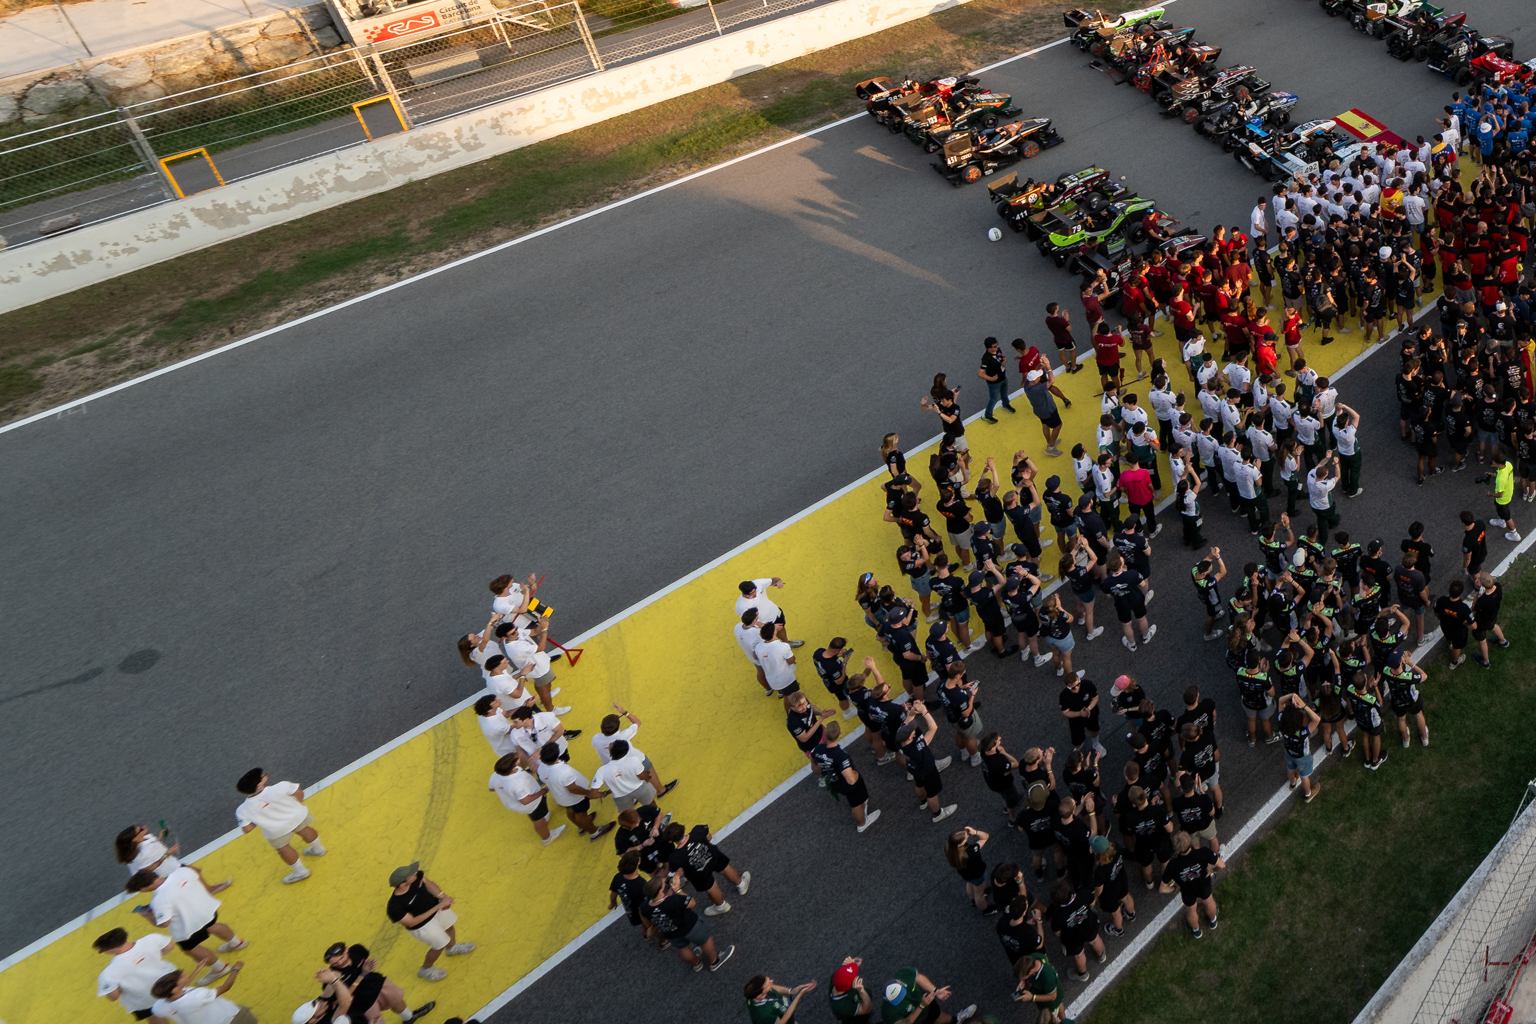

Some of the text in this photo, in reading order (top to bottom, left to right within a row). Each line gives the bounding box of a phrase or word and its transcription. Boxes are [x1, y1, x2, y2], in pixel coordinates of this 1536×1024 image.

[439, 0, 479, 14] Circuit de
[441, 5, 481, 20] Barcelona
[1304, 162, 1318, 174] 492
[1015, 209, 1028, 221] 411
[1072, 224, 1082, 234] 79
